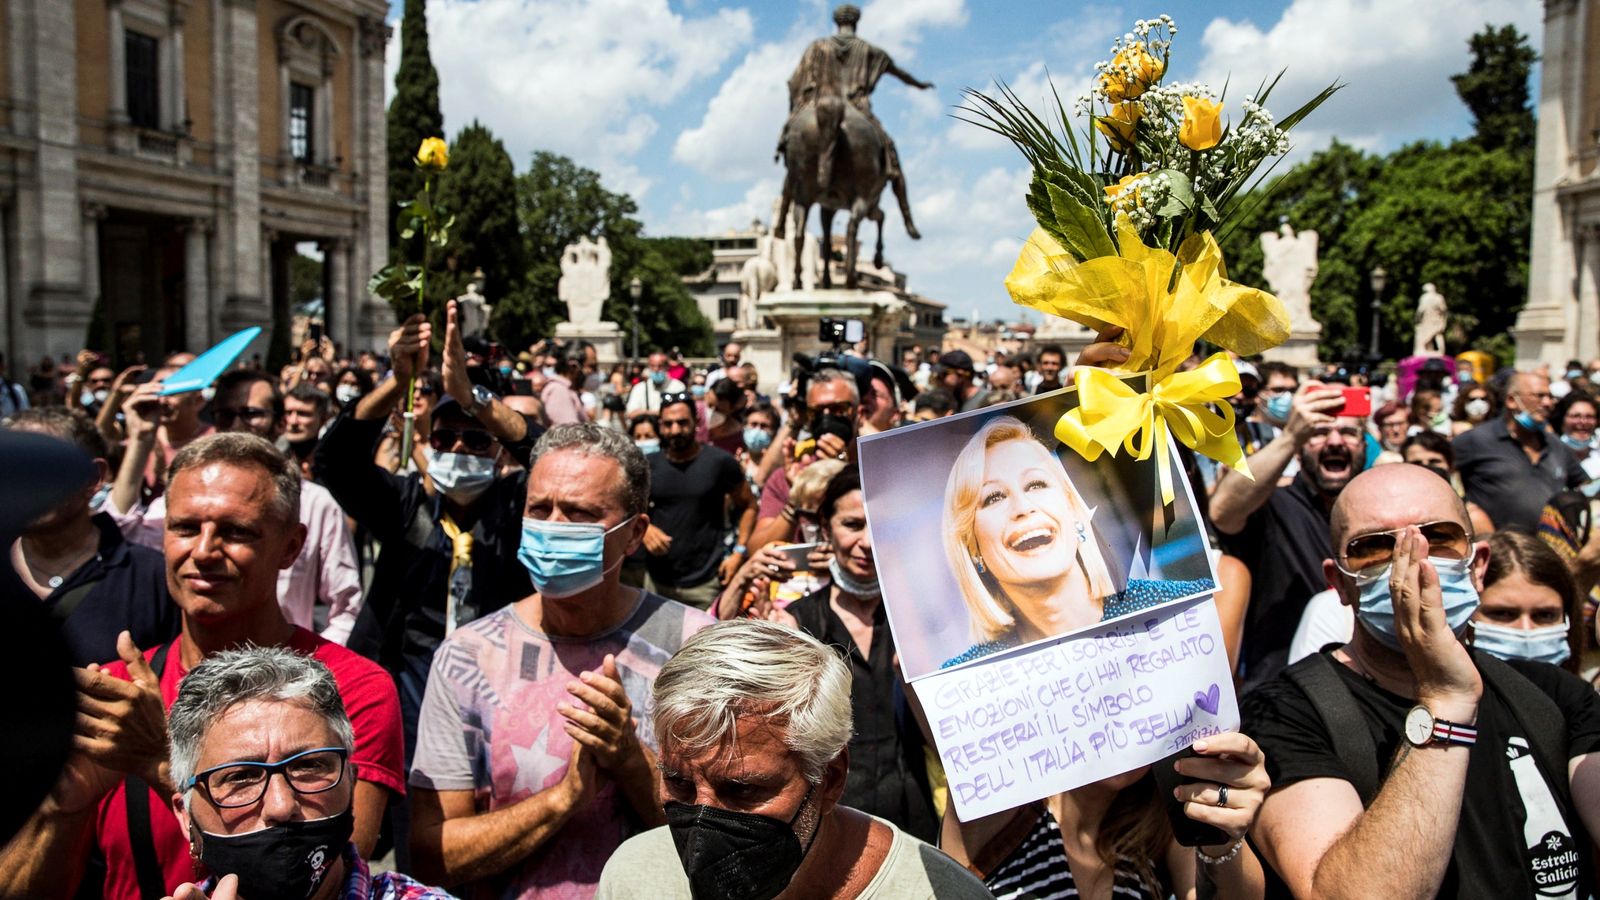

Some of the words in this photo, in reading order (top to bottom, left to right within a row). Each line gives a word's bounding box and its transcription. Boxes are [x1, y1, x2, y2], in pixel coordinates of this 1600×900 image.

[1016, 651, 1061, 680] PER
[1144, 618, 1164, 641] E
[1174, 608, 1200, 632] LE
[1037, 677, 1075, 707] CHE
[1096, 656, 1122, 685] HAI
[1126, 633, 1215, 679] REGALATO
[944, 712, 1043, 774] RESTERAI
[955, 758, 1015, 806] DELL'
[1023, 736, 1087, 783] ITALIA
[1088, 720, 1128, 761] PIÙ
[1129, 703, 1193, 746] BELLA
[1531, 850, 1579, 871] Estrella
[1535, 866, 1579, 885] Galicia
